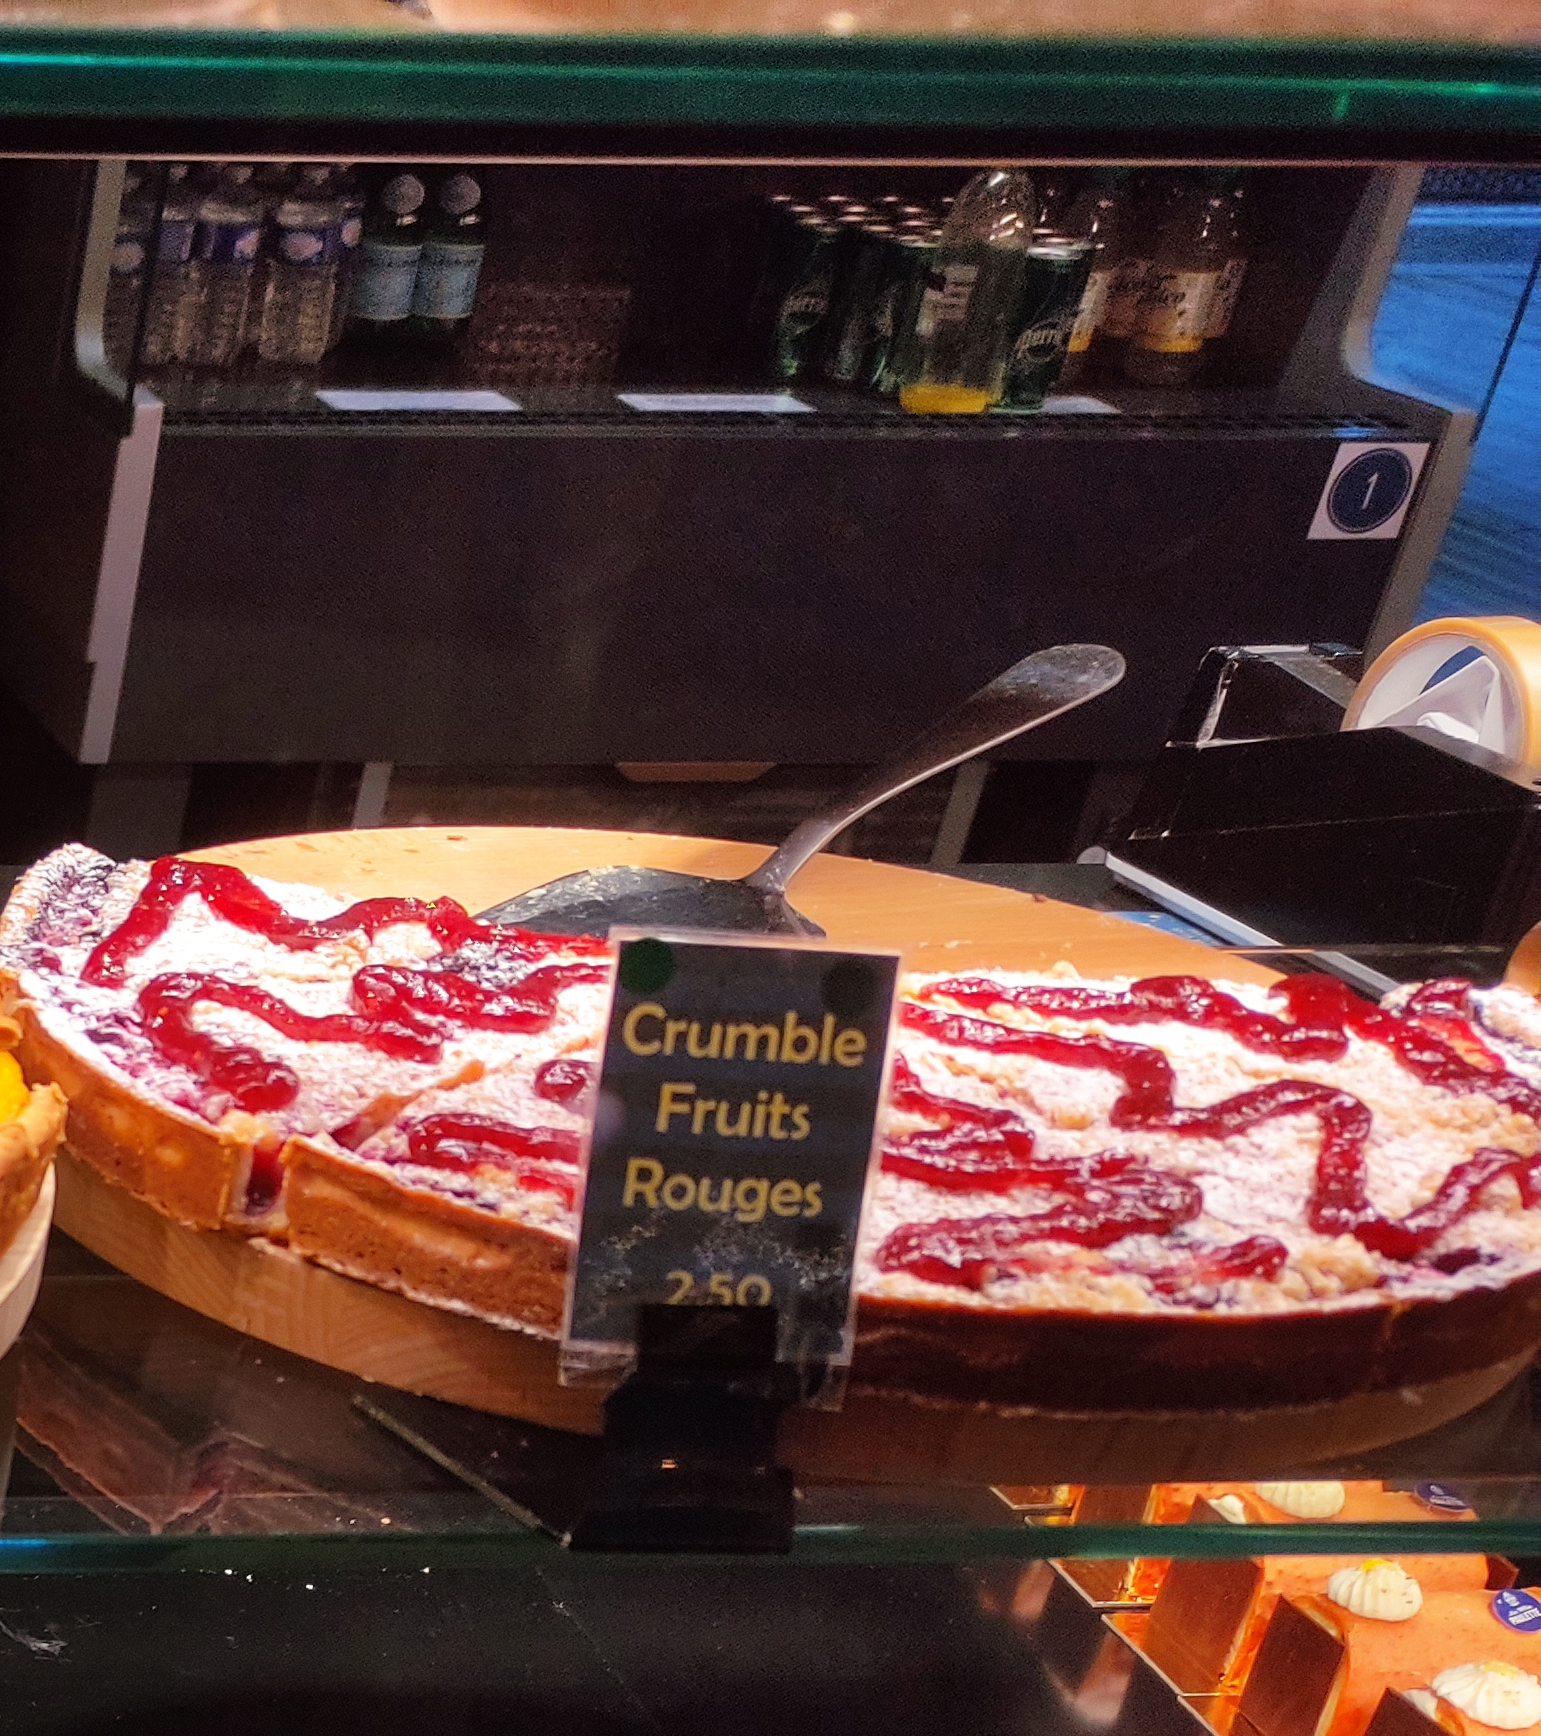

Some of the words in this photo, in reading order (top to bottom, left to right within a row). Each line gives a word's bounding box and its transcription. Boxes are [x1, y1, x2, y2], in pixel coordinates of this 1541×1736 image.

[1361, 472, 1379, 511] 1
[622, 1002, 867, 1068] Crumble
[655, 1082, 811, 1141] Fruits
[623, 1157, 822, 1223] Rouges
[666, 1270, 774, 1306] 250
